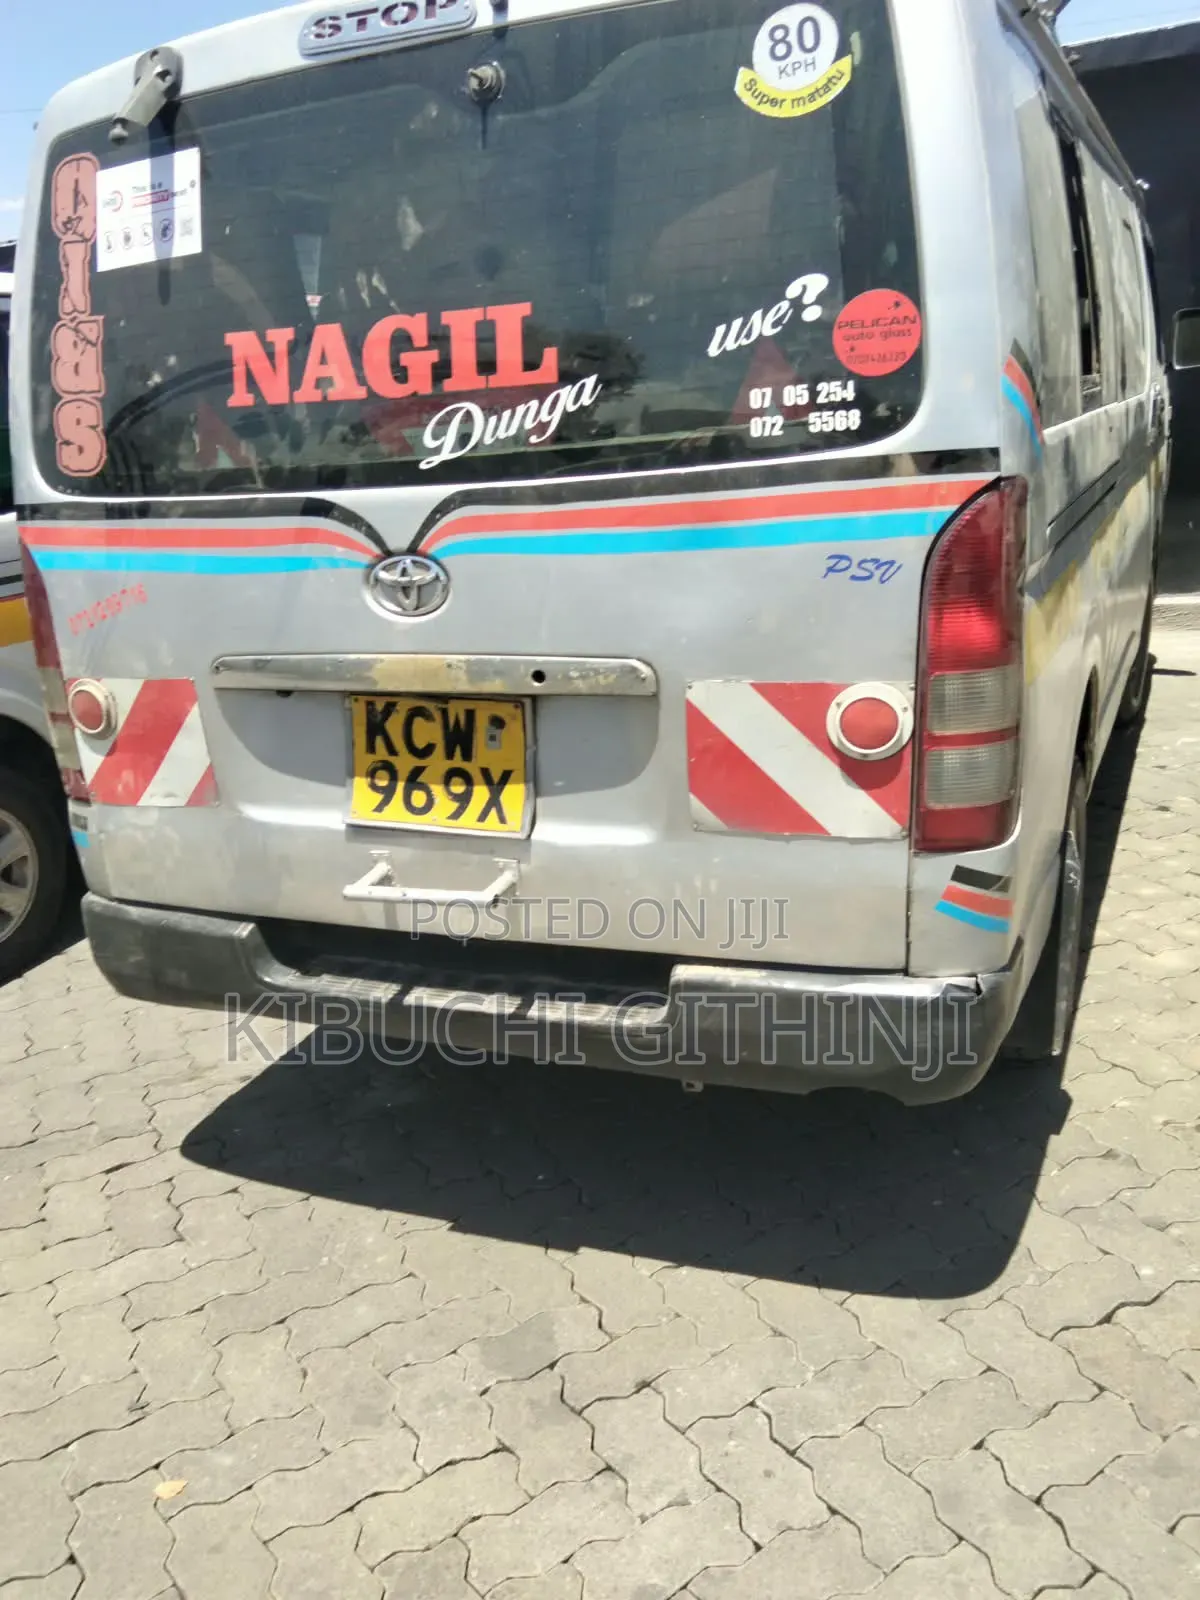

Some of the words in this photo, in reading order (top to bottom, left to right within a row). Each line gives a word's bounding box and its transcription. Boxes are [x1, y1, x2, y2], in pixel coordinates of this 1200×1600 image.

[313, 0, 457, 39] STOP
[768, 16, 821, 61] 80
[778, 57, 816, 79] KPH
[744, 78, 787, 109] Super
[791, 69, 844, 108] matatu
[838, 315, 917, 330] PELICAN
[224, 302, 558, 407] NAGIL
[749, 387, 773, 409] 07
[782, 384, 809, 407] 05
[816, 380, 856, 404] 254
[418, 373, 602, 470] Dunga
[750, 415, 784, 438] 072
[808, 409, 861, 433] 5568
[822, 554, 903, 584] PSV
[365, 699, 476, 762] KCW
[366, 759, 514, 825] 969X
